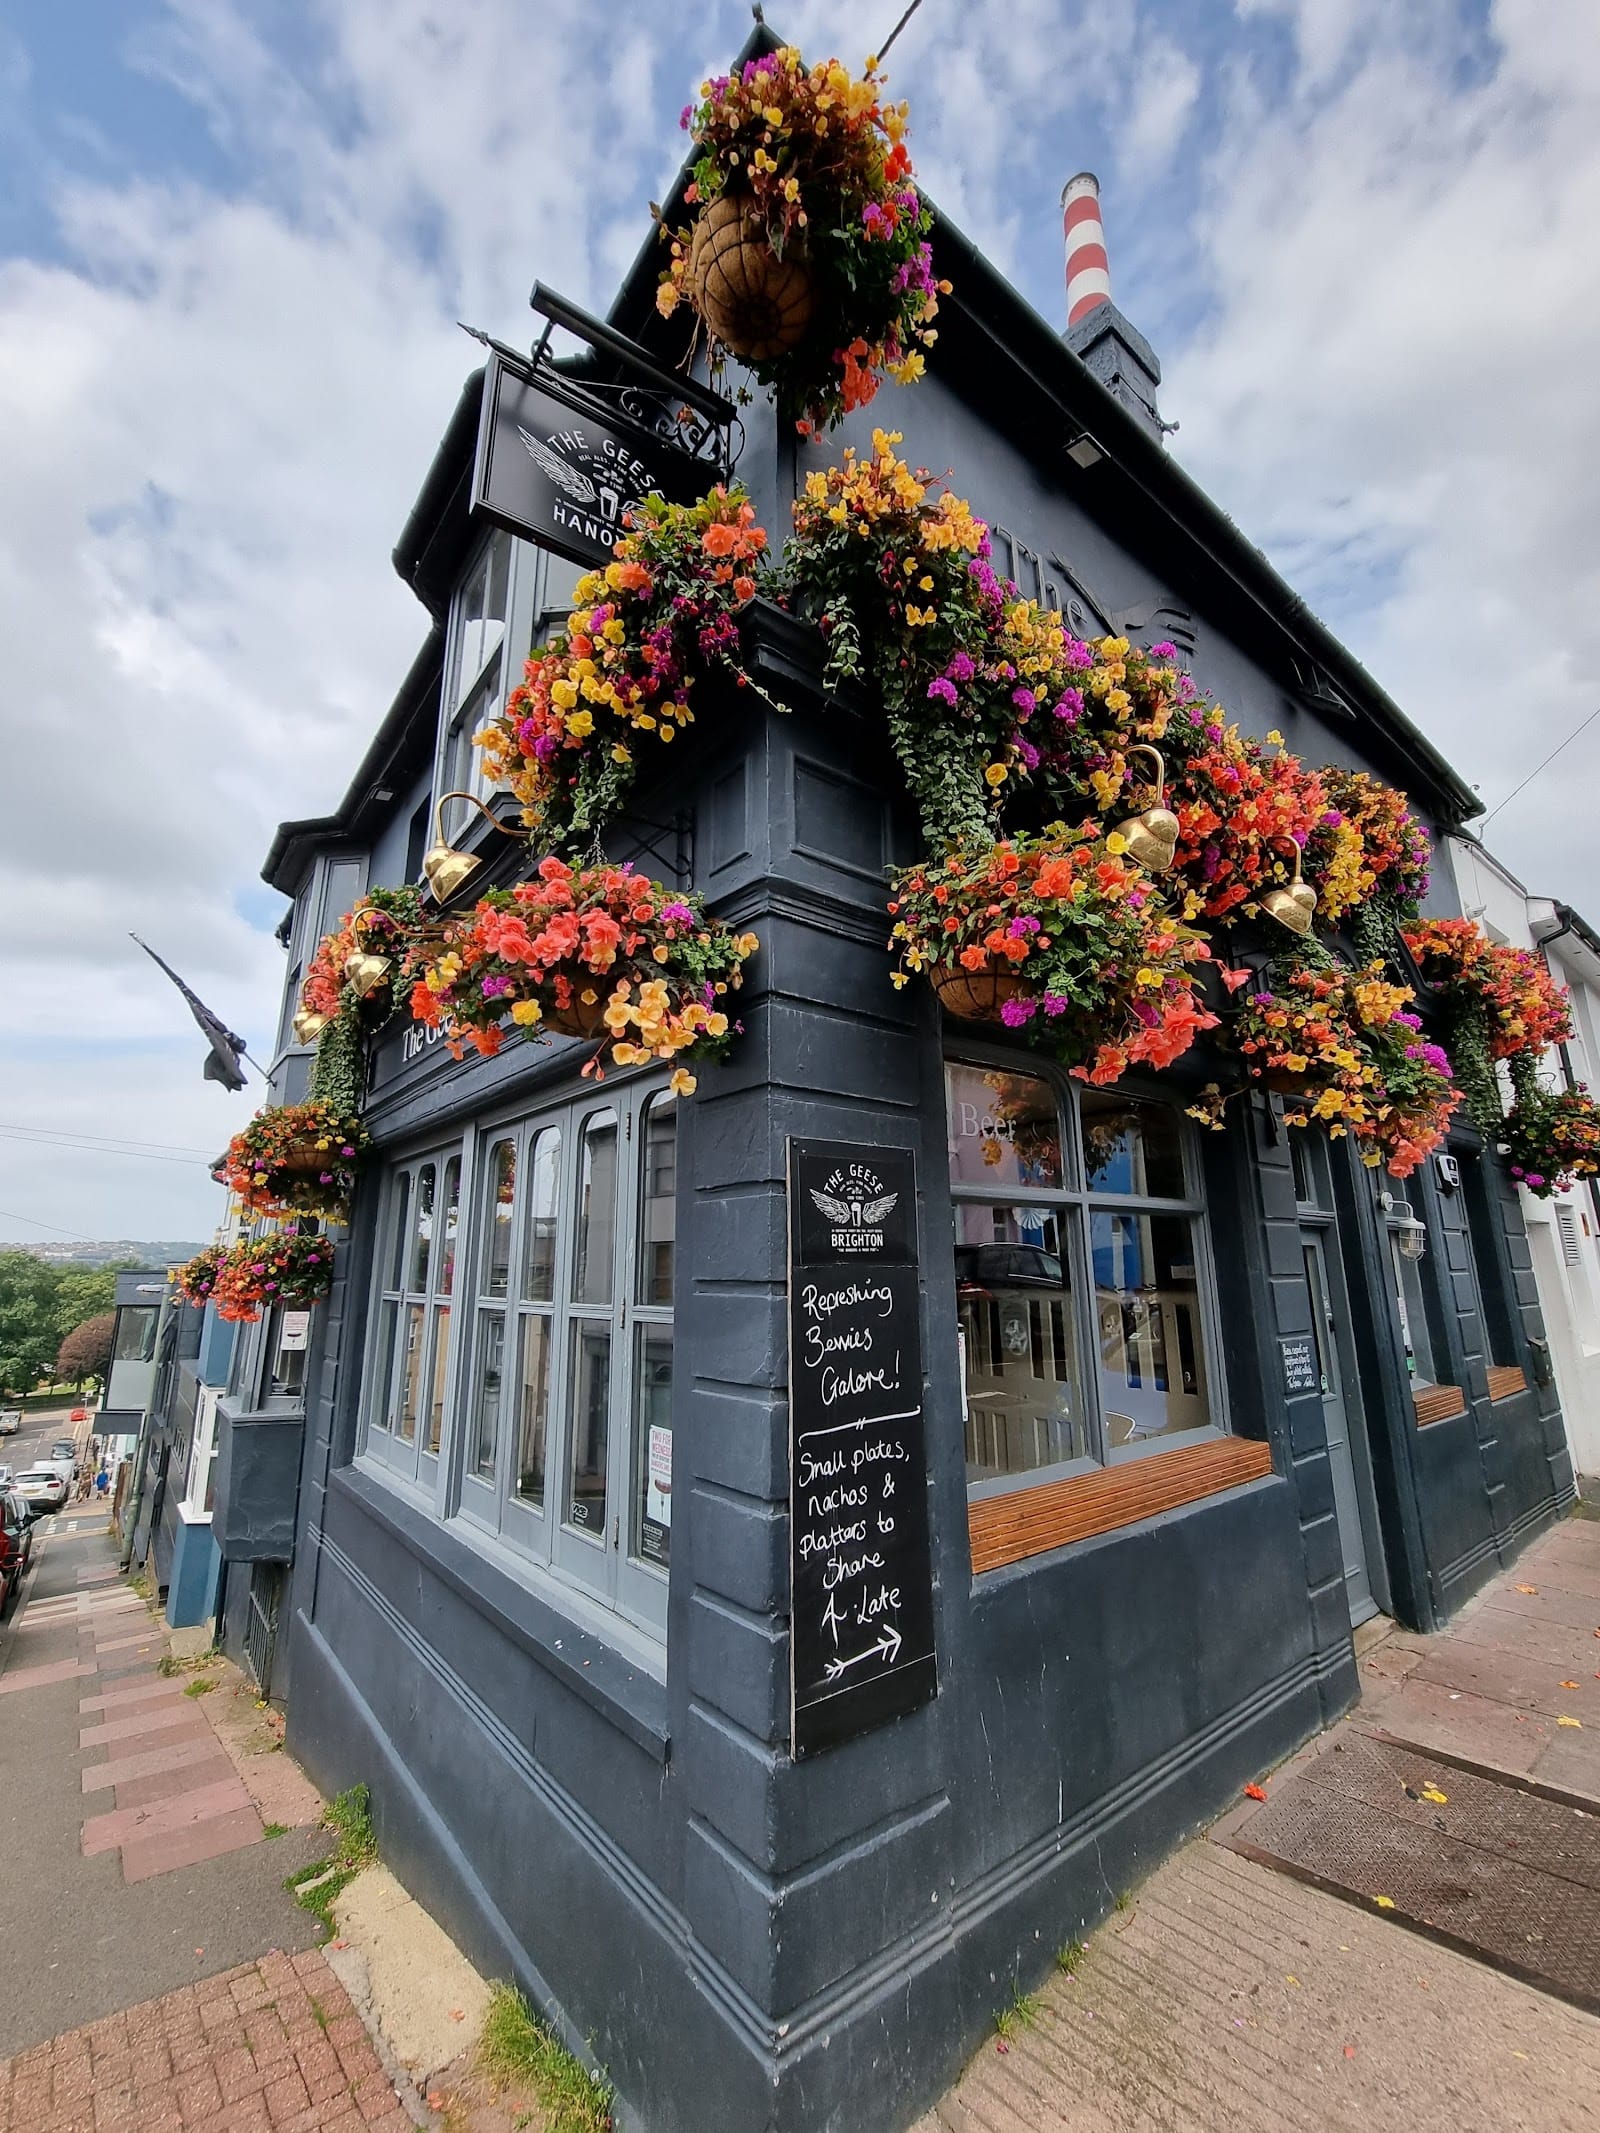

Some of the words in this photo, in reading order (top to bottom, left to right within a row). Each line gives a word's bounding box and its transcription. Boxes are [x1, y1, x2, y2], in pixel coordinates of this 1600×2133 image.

[547, 431, 588, 454] THE
[402, 1024, 424, 1063] The
[960, 1102, 1017, 1141] Beer
[823, 1168, 844, 1194] THE
[849, 1163, 884, 1194] GEESE
[831, 1233, 884, 1247] BRIGHTON
[802, 1278, 893, 1321] Refreshing
[821, 1349, 901, 1406] Galore!
[799, 1450, 846, 1487] Small
[851, 1440, 910, 1474] plates,
[808, 1484, 868, 1517] nachos
[882, 1472, 895, 1498] &
[799, 1518, 867, 1561] platters
[877, 1510, 895, 1534] to
[857, 1584, 902, 1625] Late
